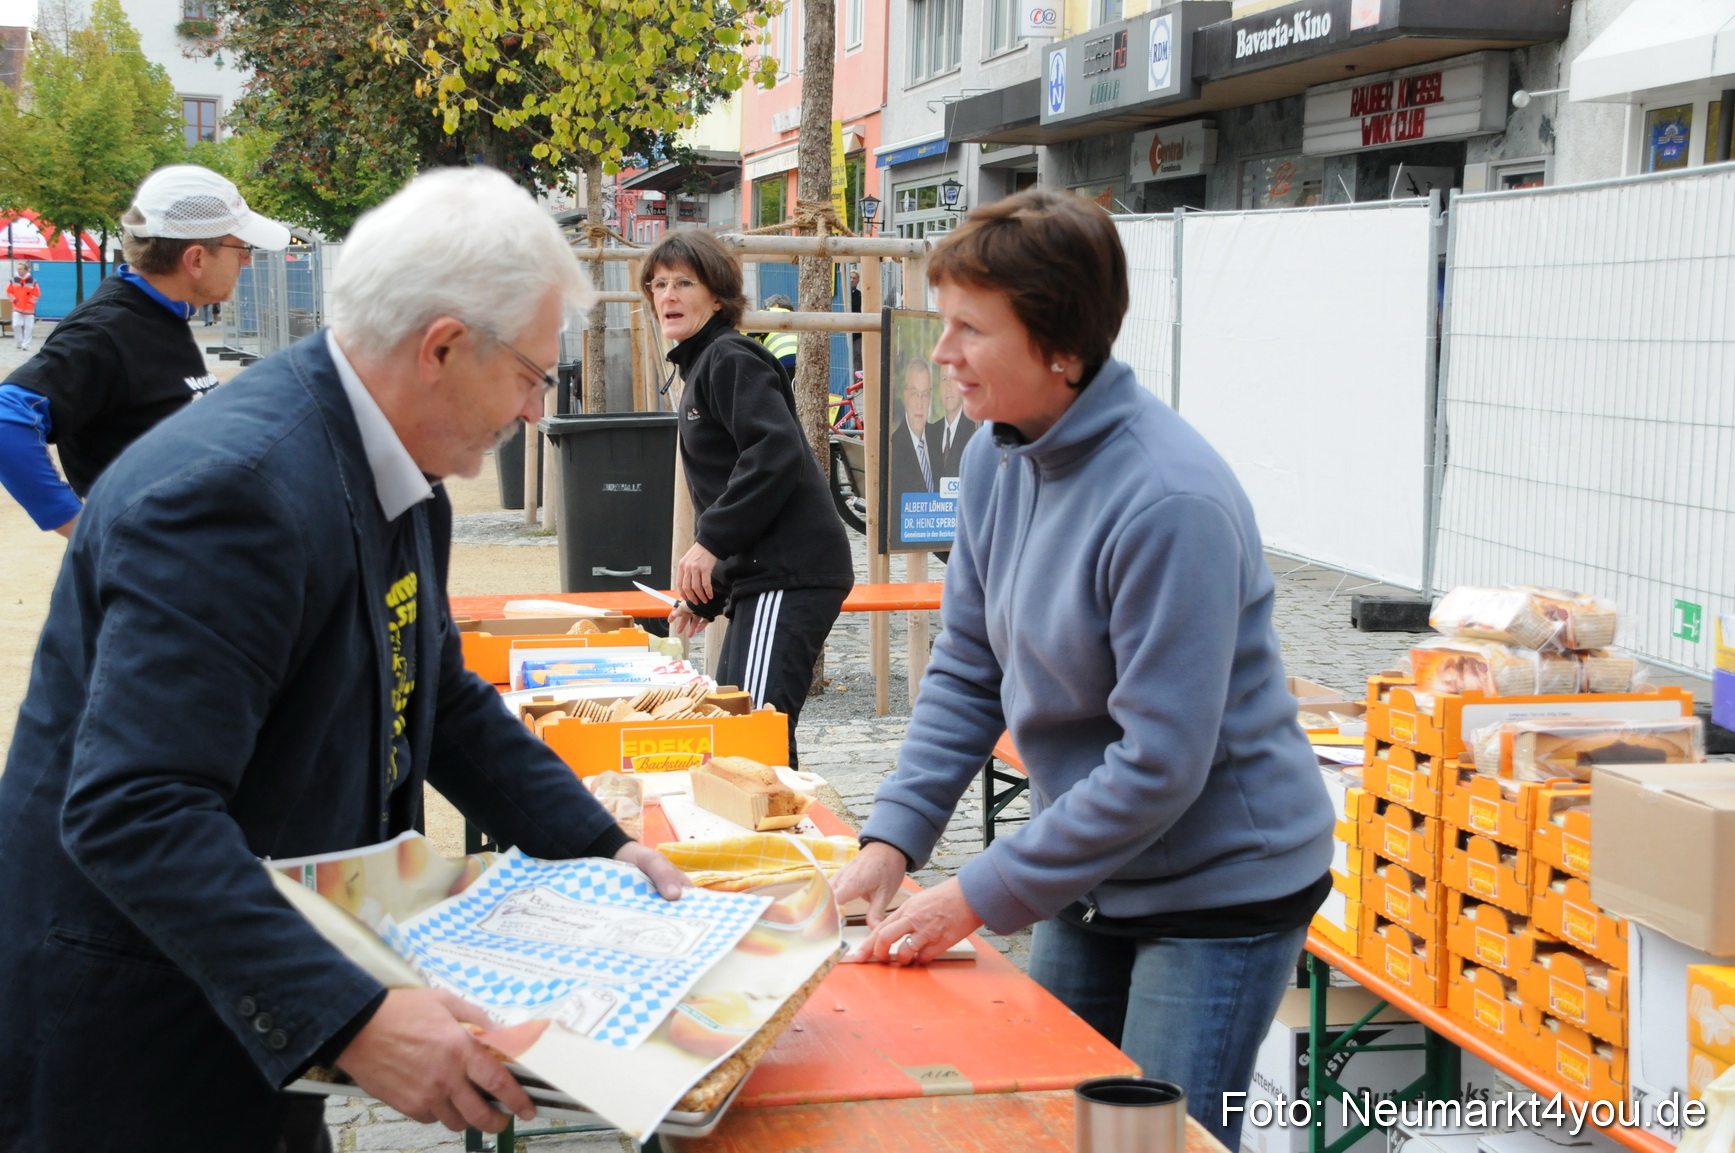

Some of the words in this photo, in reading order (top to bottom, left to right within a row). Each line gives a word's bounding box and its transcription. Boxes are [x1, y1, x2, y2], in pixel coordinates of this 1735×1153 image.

[1235, 10, 1331, 59] Bavaria-Kino
[1152, 40, 1168, 63] RDM
[904, 502, 928, 512] ALBERT
[929, 500, 953, 512] LÖHNER
[904, 518, 914, 528] DR.
[916, 518, 935, 528] HEINZ
[623, 738, 711, 757] EDEKA
[636, 755, 700, 773] Backstube
